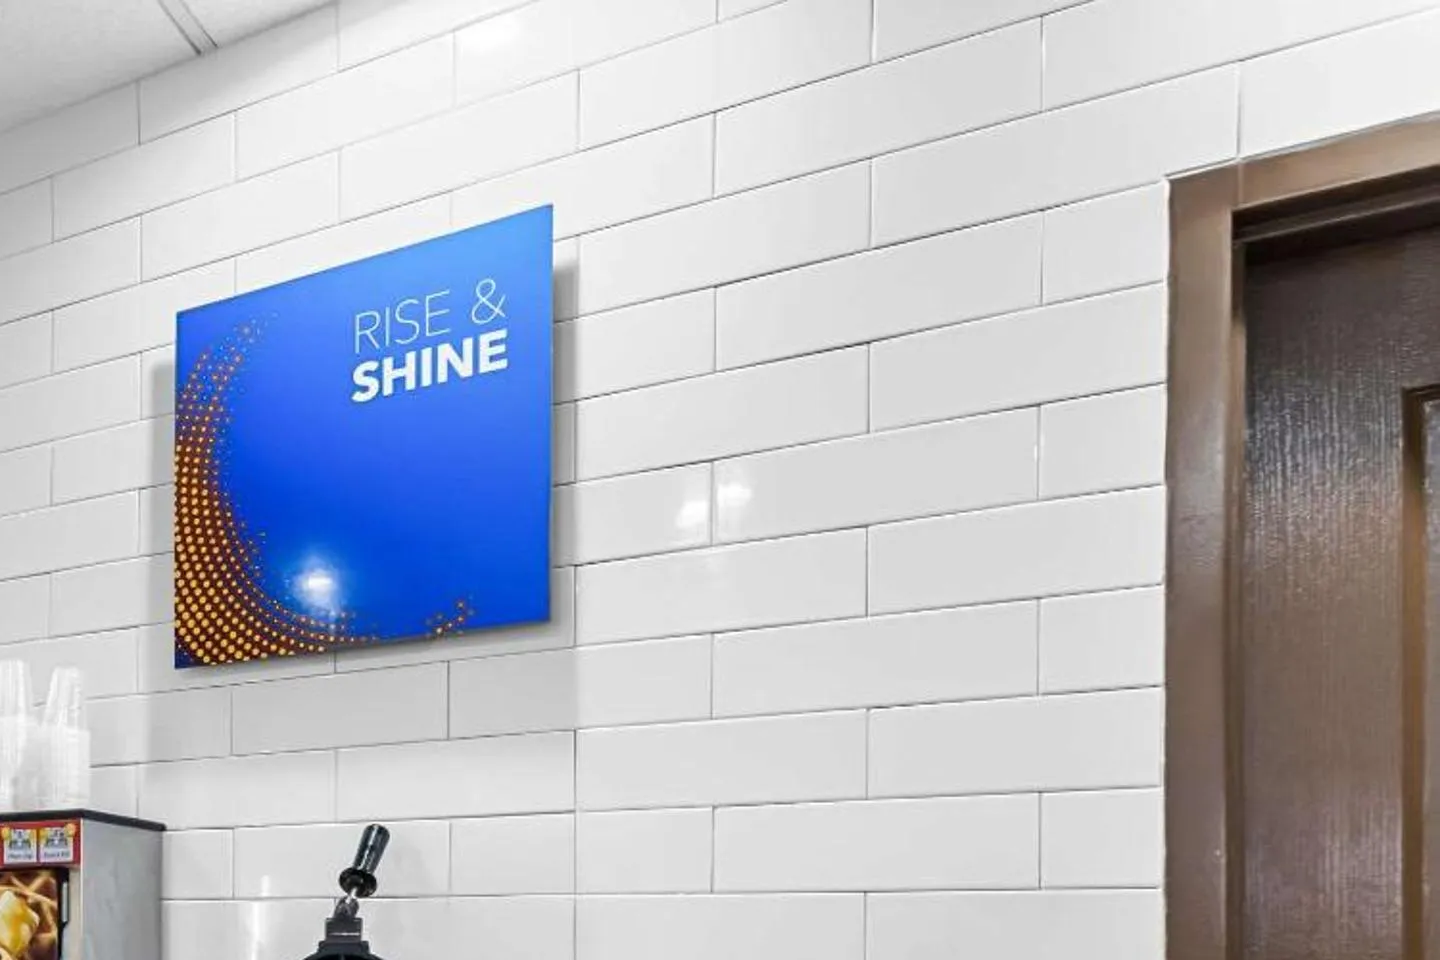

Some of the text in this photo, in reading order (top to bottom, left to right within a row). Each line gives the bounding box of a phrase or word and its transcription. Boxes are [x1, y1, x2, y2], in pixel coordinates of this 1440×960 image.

[355, 278, 506, 354] RISE &
[351, 328, 508, 402] SHINE
